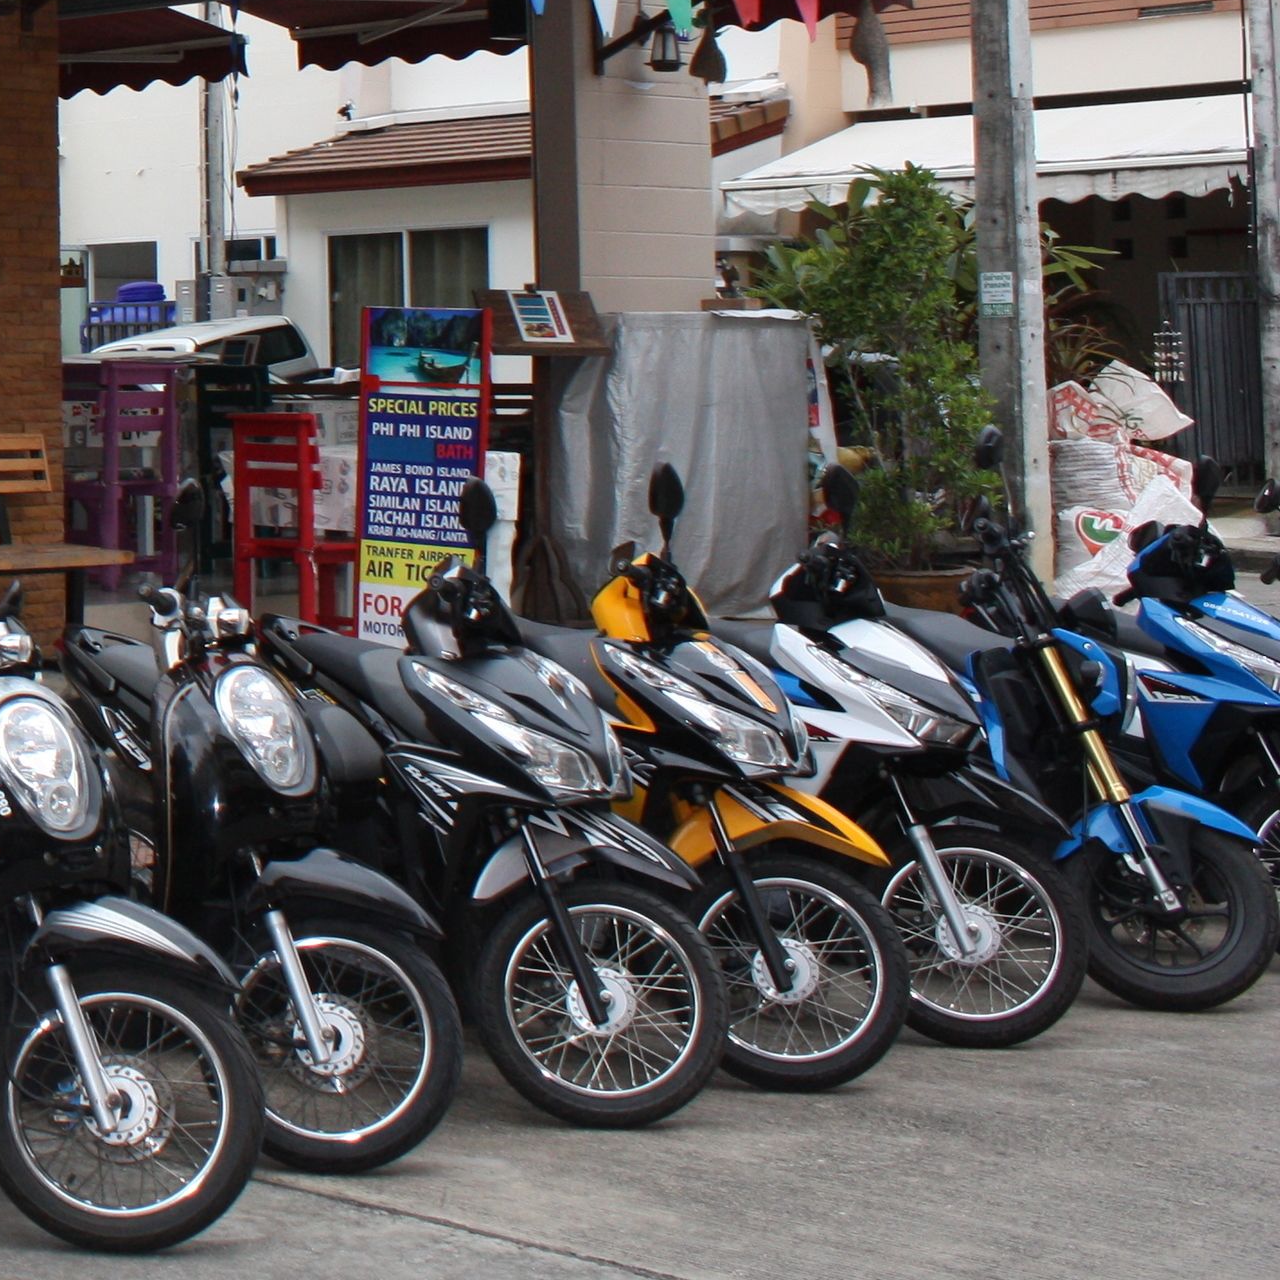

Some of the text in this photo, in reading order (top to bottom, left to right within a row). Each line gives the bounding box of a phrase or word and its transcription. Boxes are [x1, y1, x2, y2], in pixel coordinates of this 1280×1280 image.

[368, 398, 478, 417] SPECIAL PRICES
[372, 422, 472, 440] PHI PHI ISLAND
[436, 443, 474, 460] BATH
[370, 462, 472, 478] JAMES BOND ISLAND
[369, 475, 409, 493] RAYA
[368, 494, 461, 514] SIMILAN ISLAN
[367, 509, 416, 526] TACHAI
[367, 524, 394, 536] KRABI
[366, 545, 414, 560] TRANFER
[366, 560, 394, 579] AIR
[363, 593, 403, 618] FOR
